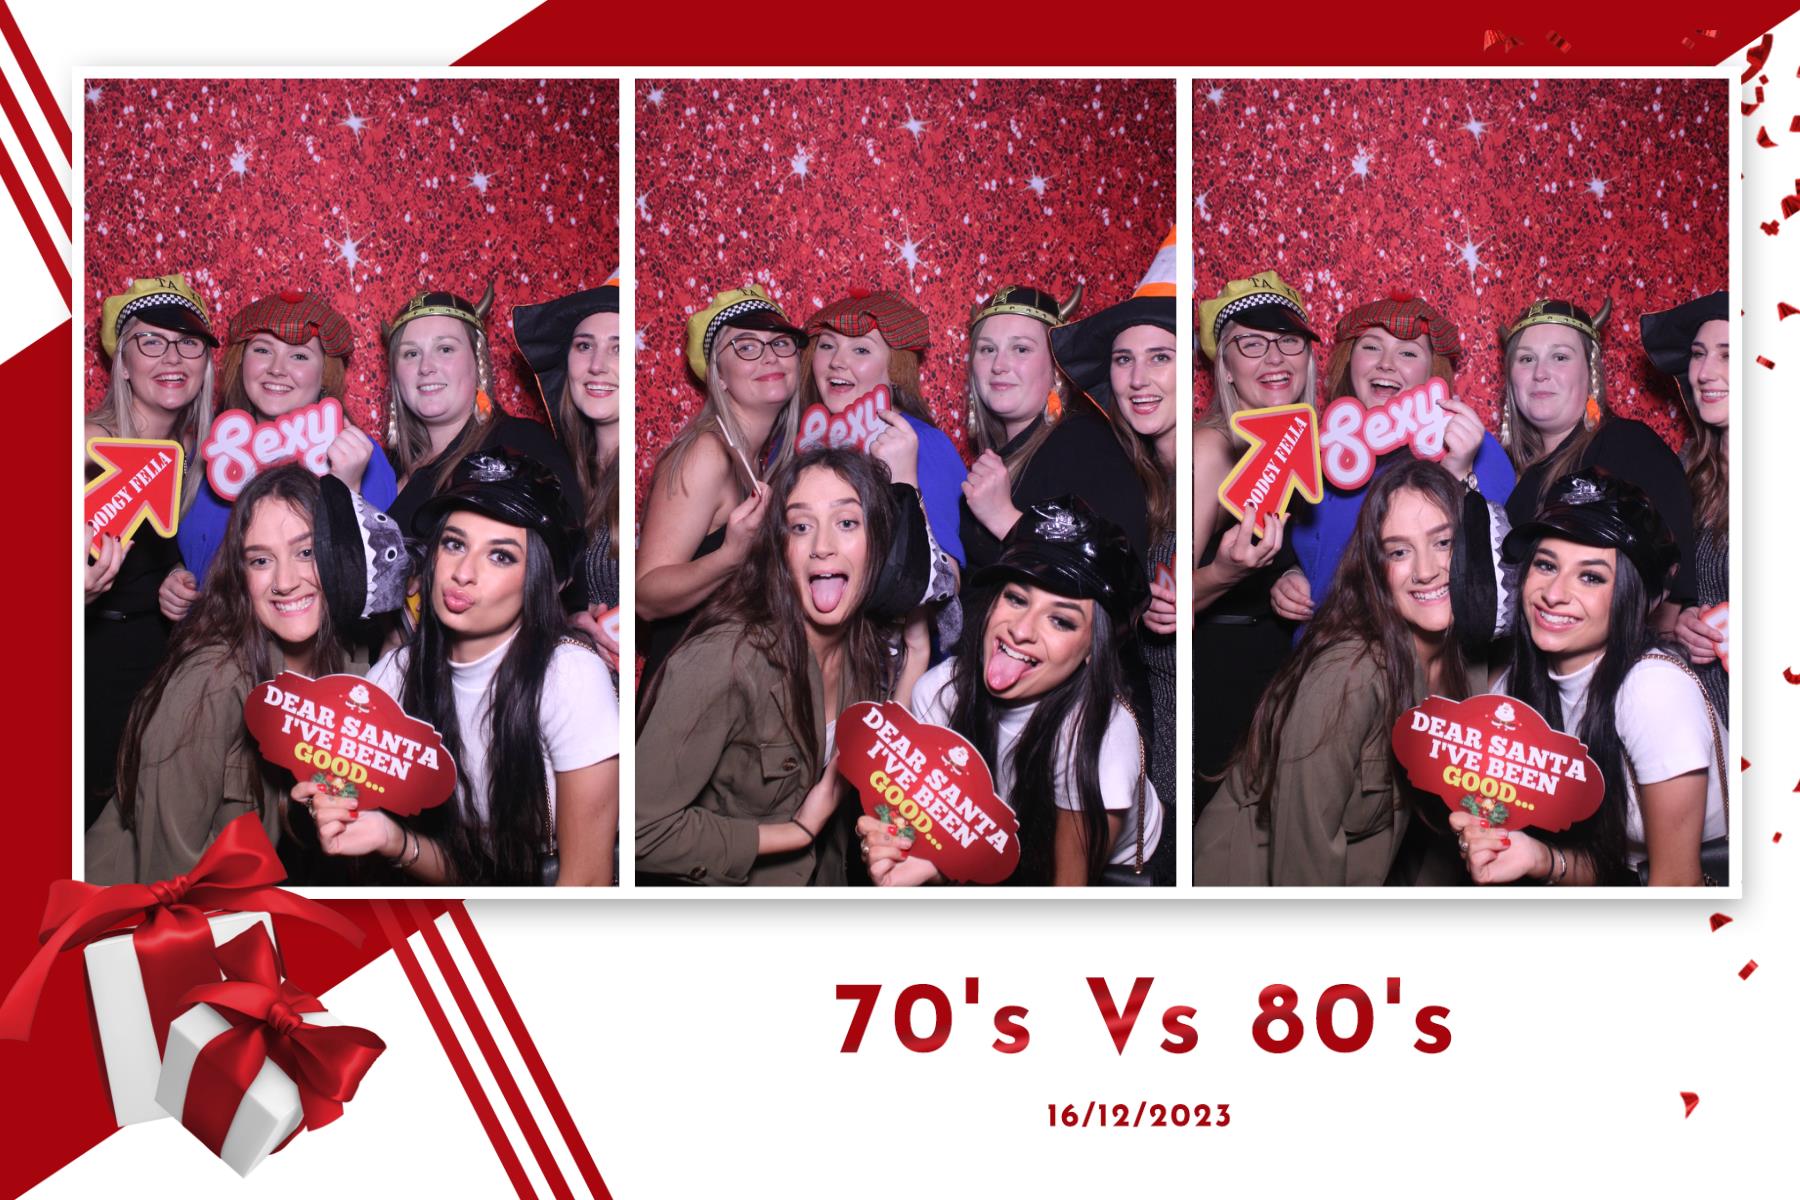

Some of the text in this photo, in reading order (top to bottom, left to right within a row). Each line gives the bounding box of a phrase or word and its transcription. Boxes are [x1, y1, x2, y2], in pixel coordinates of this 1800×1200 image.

[206, 404, 337, 495] Sexy
[1274, 416, 1308, 463] FELLA
[1320, 382, 1450, 484] Sexy
[129, 451, 172, 493] FELLA
[264, 685, 439, 770] DEAR SANTA
[281, 714, 412, 781] I'VE BEEN
[1411, 711, 1587, 782] DEAR SANTA
[294, 742, 385, 793] GOOD...
[862, 706, 1009, 854] DEAR SANTA
[867, 740, 978, 849] I'VE BEEN
[1429, 738, 1560, 795] I'VE BEEN
[1443, 765, 1534, 811] GOOD...
[870, 770, 942, 850] GOOD...
